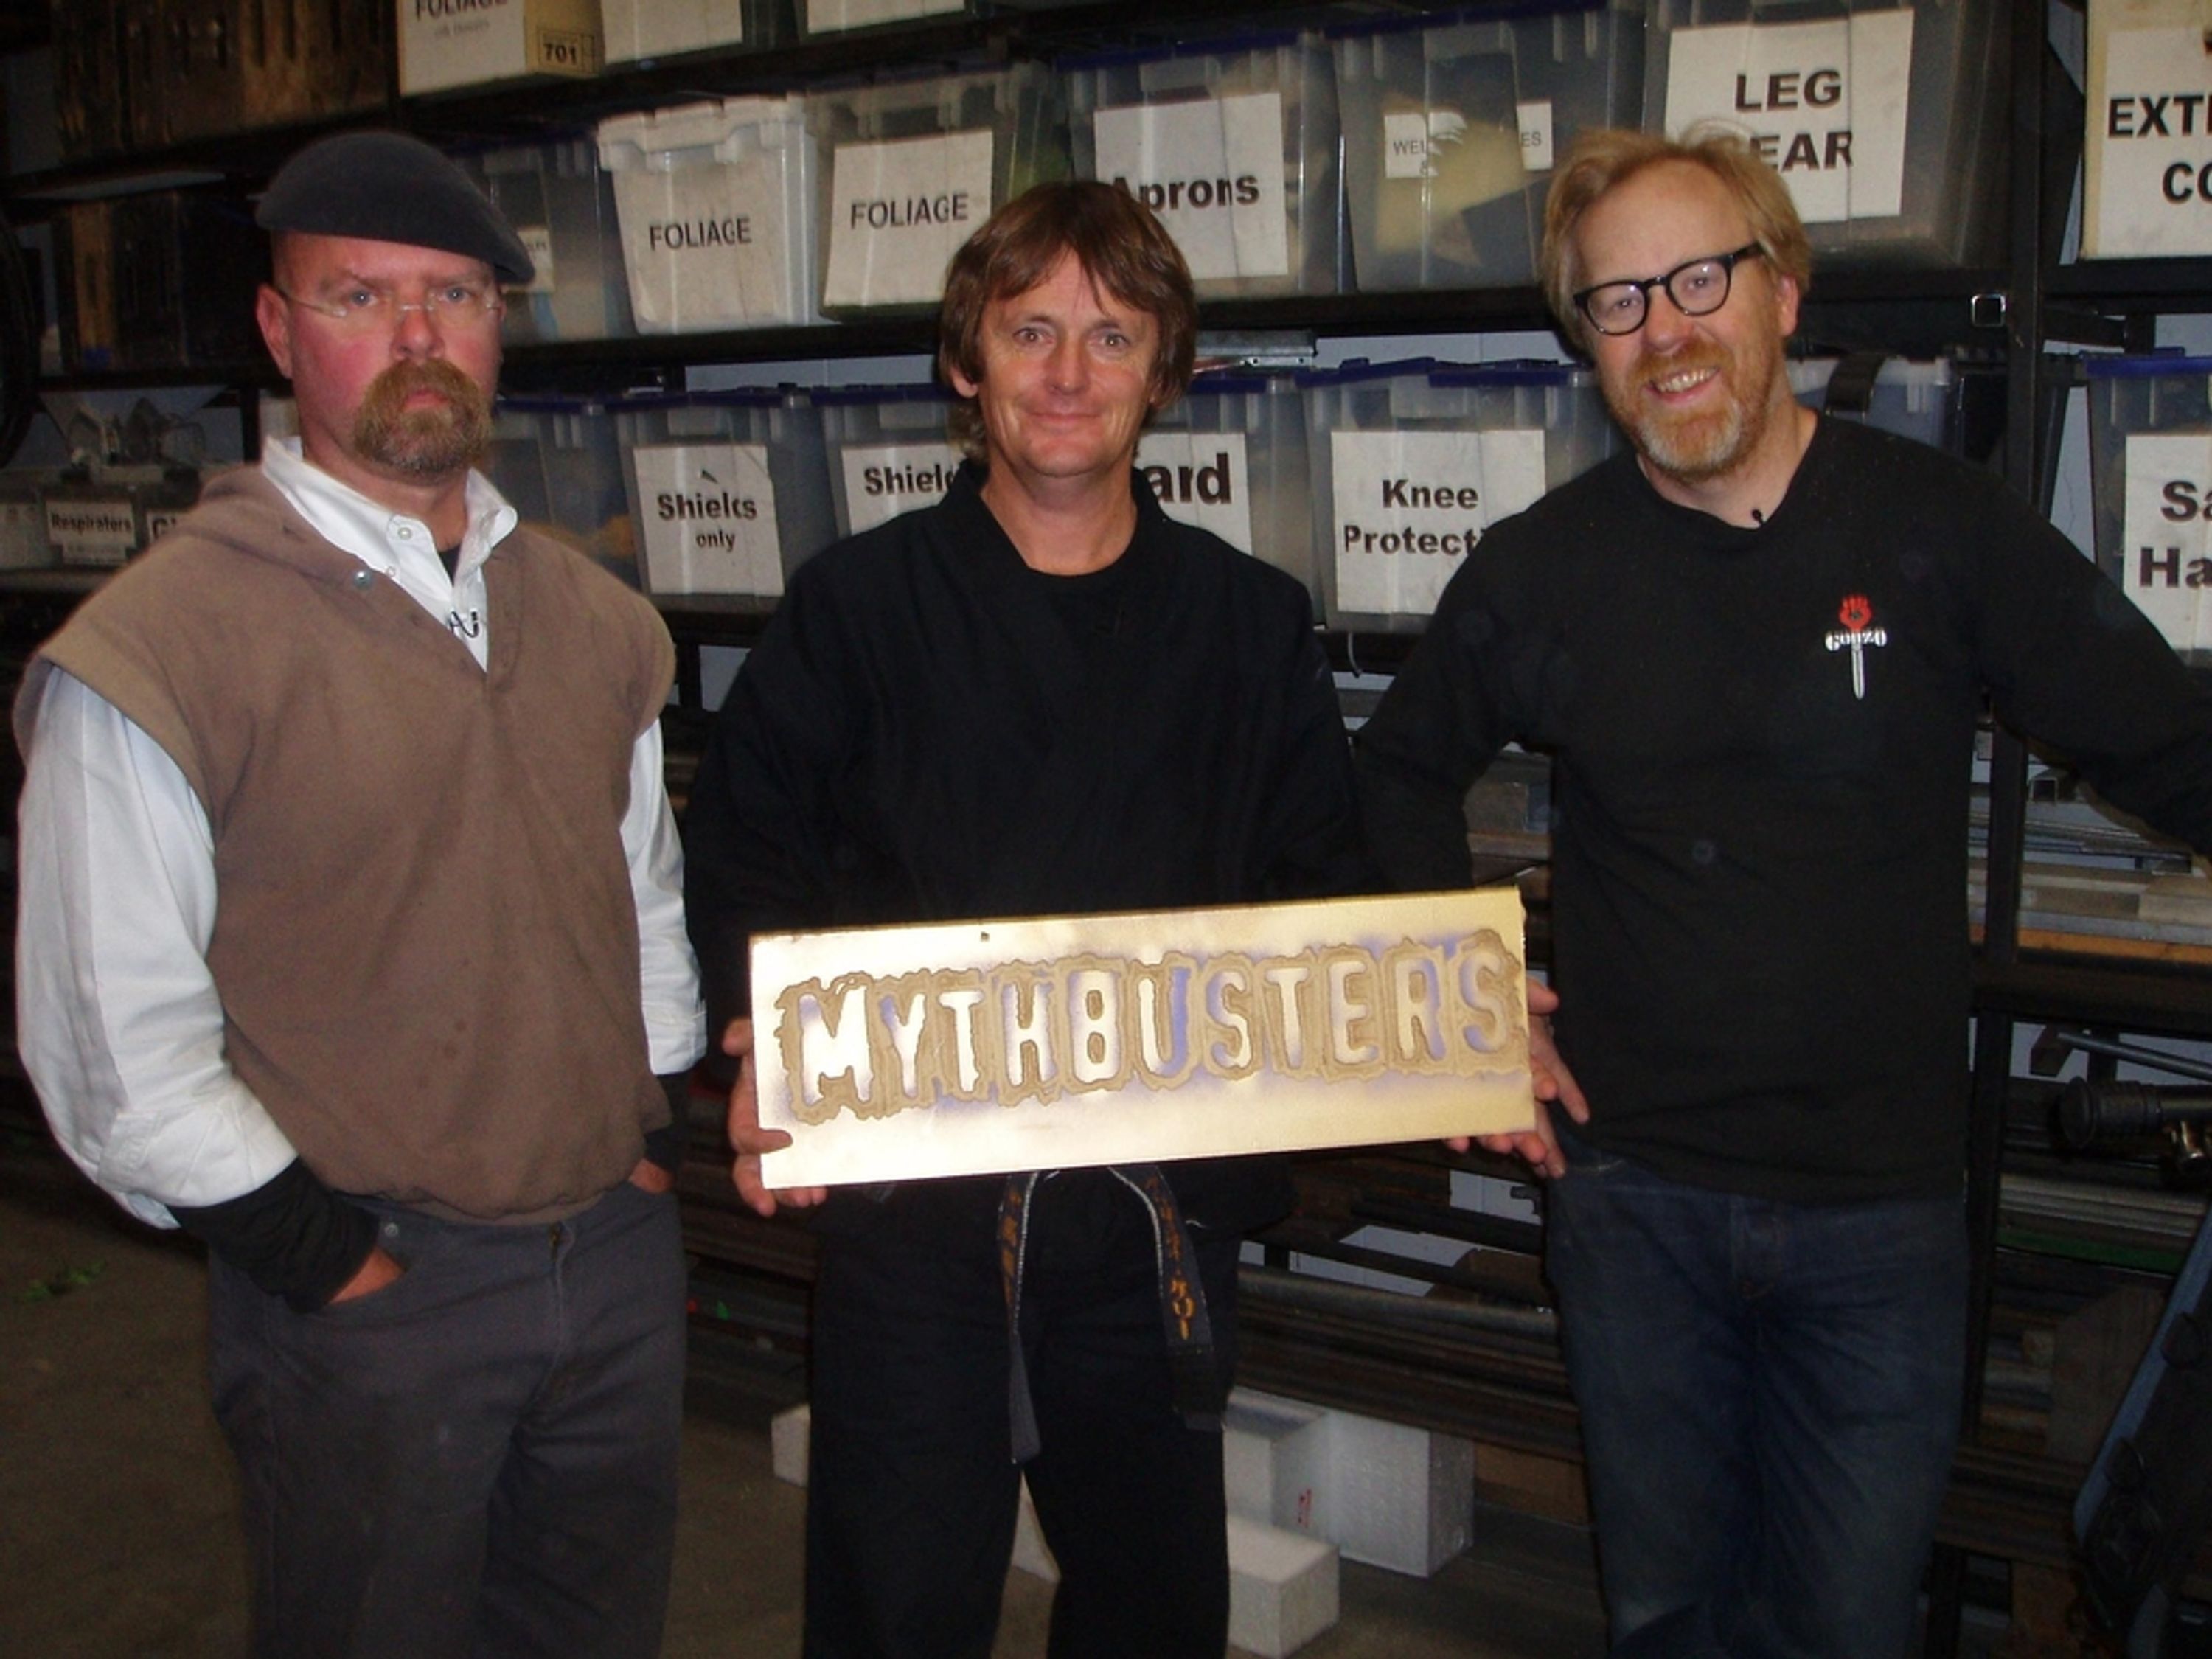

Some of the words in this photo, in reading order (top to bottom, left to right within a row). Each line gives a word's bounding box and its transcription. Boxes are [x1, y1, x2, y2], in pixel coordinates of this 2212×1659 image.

[416, 0, 507, 21] FOLI
[543, 43, 577, 65] 701
[1735, 69, 1842, 112] LEG
[1520, 131, 1542, 147] ES
[1749, 128, 1853, 171] EAR
[849, 193, 970, 229] FOLIAGE
[649, 218, 752, 251] FOLIAGE
[1144, 451, 1232, 506] ard
[1382, 479, 1479, 509] Knee
[2160, 480, 2212, 523] S
[695, 529, 736, 552] only
[1344, 524, 1487, 557] Protect
[790, 944, 1517, 1112] MYTHBUSTERS
